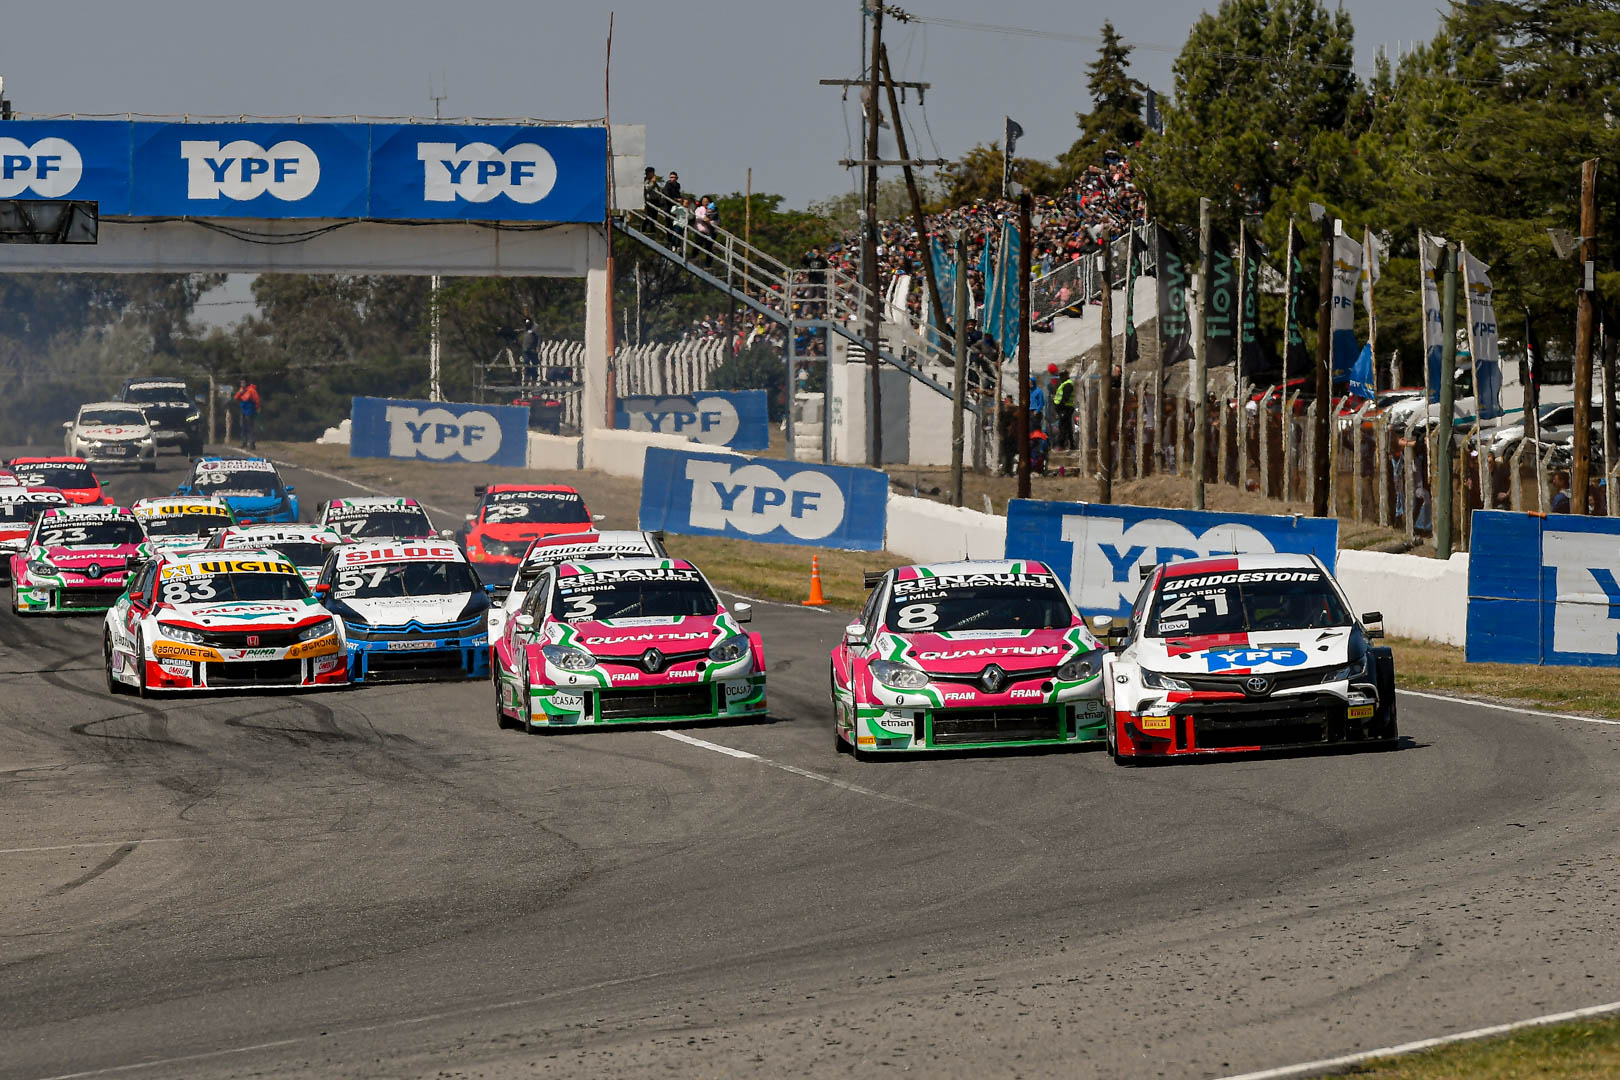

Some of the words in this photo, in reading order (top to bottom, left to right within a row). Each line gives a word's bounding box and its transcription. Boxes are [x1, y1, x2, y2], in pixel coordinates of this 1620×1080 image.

[203, 158, 300, 182] YPF
[440, 160, 536, 186] YPF
[1206, 250, 1231, 338] flow
[643, 411, 722, 433] YPF
[405, 422, 487, 447] YPF
[15, 462, 87, 471] Taraborelli
[195, 472, 228, 486] 49
[493, 491, 579, 502] Taraborelli
[710, 480, 821, 519] YPF
[50, 521, 103, 529] MONTENEGRO
[329, 519, 368, 536] 17
[41, 528, 87, 546] 23
[345, 547, 454, 562] SILOC
[534, 544, 648, 558] BRIDGESTONE
[170, 574, 216, 583] ARDUSSO
[338, 568, 387, 591] 57
[557, 568, 699, 588] RENAULT
[893, 573, 1054, 593] RENAULT
[1162, 572, 1321, 592] BRIDGESTONE
[163, 579, 217, 604] 83
[573, 584, 616, 593] PERNIA
[1179, 588, 1227, 597] BARRIO
[909, 591, 948, 601] MILLA
[191, 604, 298, 616] PALADINI
[563, 595, 597, 618] 3
[1160, 593, 1229, 620] 41
[897, 603, 939, 630] 8
[1159, 620, 1189, 632] flow
[586, 631, 709, 645] QUANTIUM
[919, 645, 1059, 660] QUANTIUM
[1215, 650, 1293, 662] YPF
[161, 658, 192, 666] PEREIRA
[611, 673, 639, 681] FRAM
[669, 670, 696, 679] FRAM
[945, 691, 975, 700] FRAM
[1010, 689, 1041, 698] FRAM
